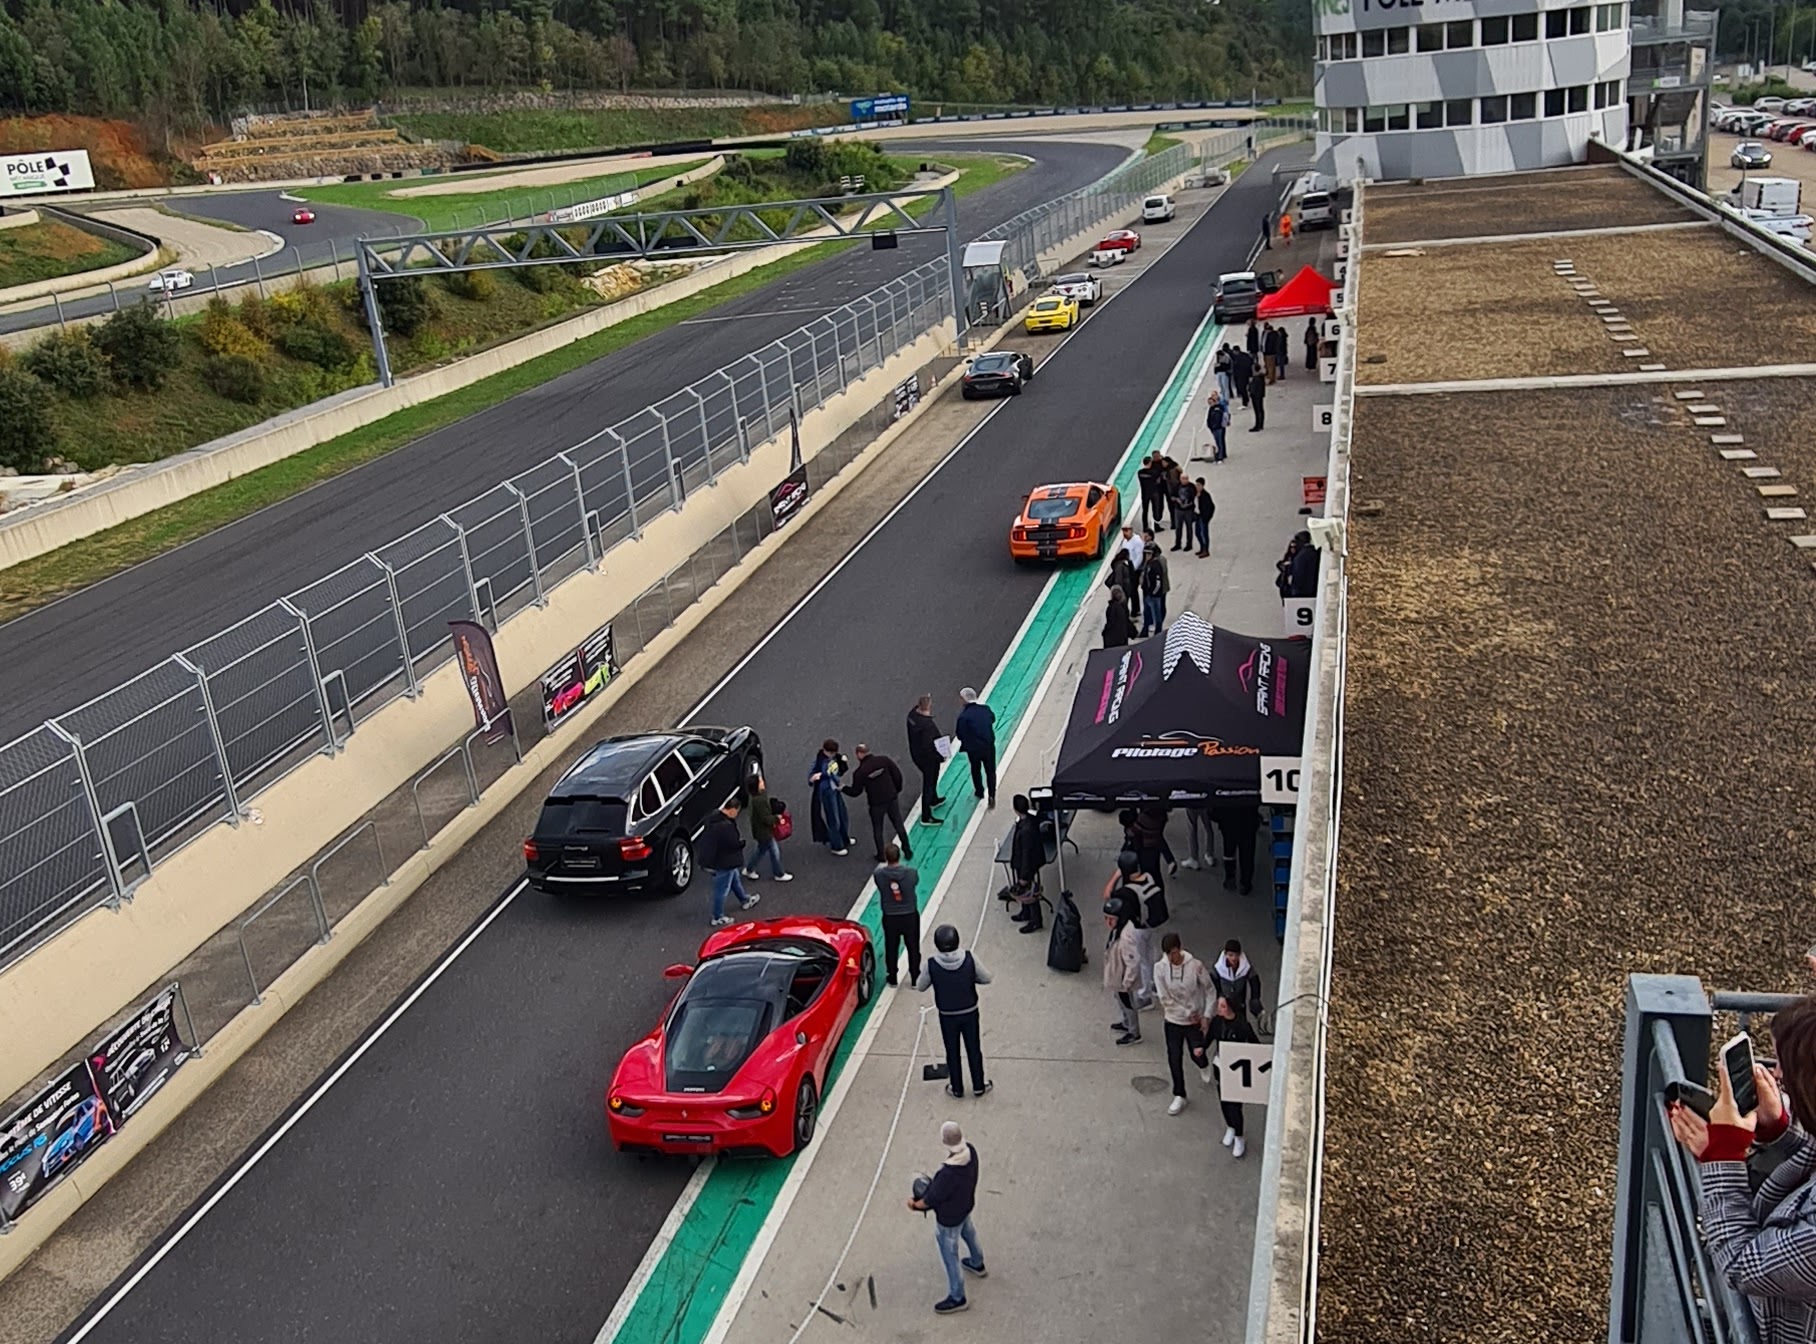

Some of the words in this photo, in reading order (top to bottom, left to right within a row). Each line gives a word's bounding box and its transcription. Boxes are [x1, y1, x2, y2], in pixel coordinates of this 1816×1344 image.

[7, 159, 44, 175] PÔLE
[1336, 293, 1344, 303] 5
[1331, 325, 1341, 336] 6
[1328, 363, 1337, 375] 7
[1321, 411, 1332, 425] 8
[1296, 607, 1313, 626] 9
[1112, 747, 1198, 758] Pilotage
[1198, 741, 1260, 756] Passion
[1266, 768, 1301, 793] 10
